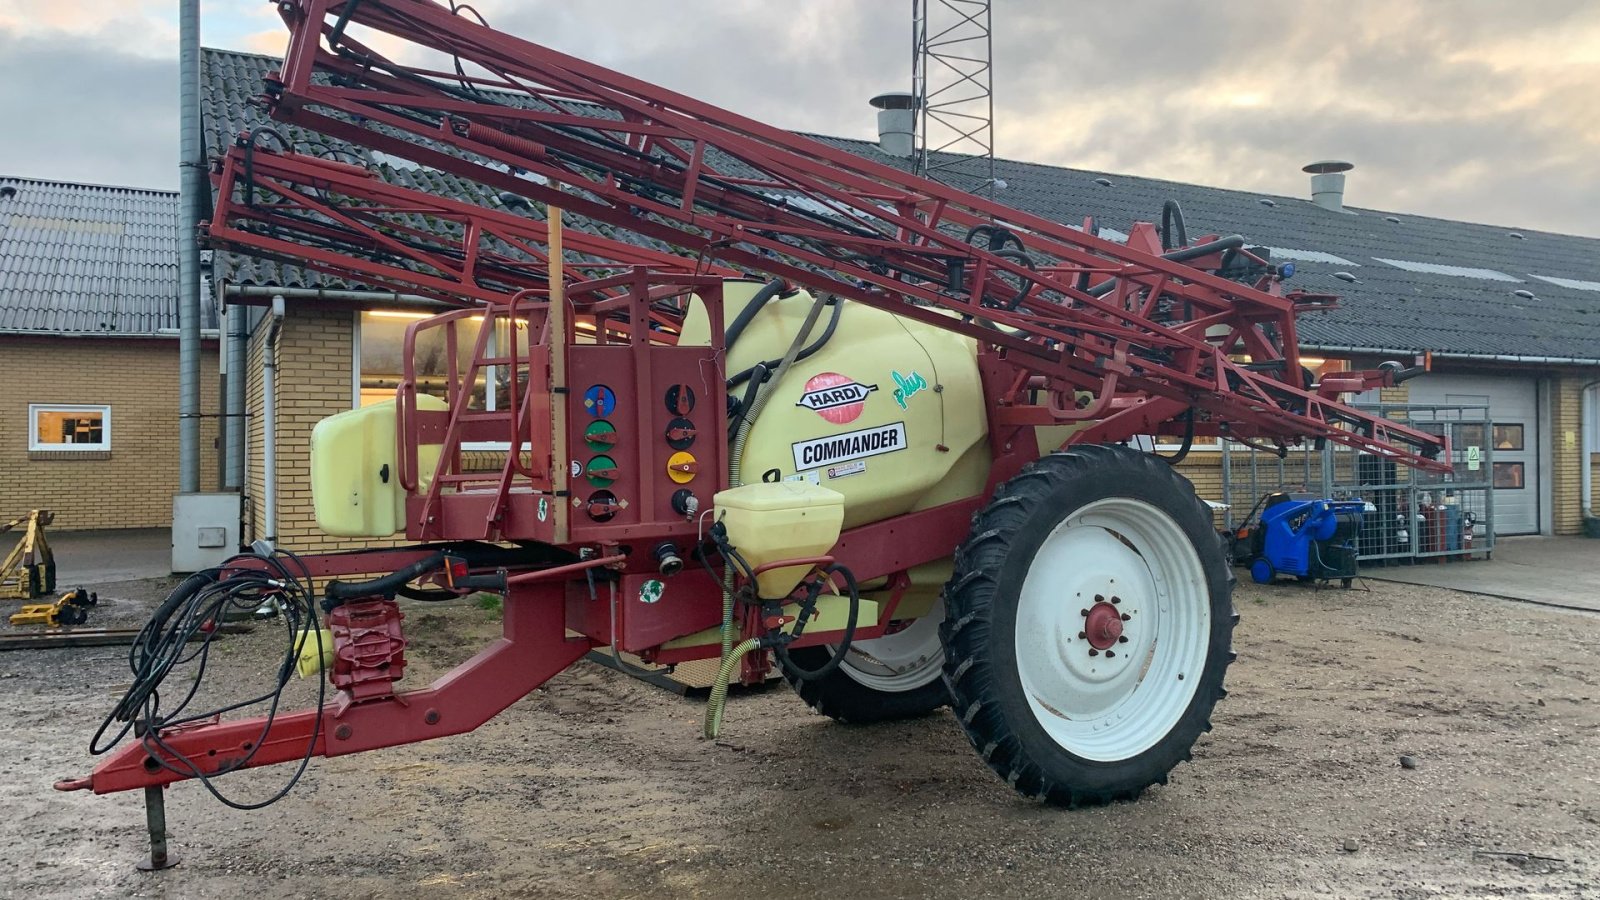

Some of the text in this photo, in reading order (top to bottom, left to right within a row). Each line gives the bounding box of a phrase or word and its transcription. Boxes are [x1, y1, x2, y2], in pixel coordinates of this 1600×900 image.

[808, 387, 862, 407] HARDI
[891, 370, 927, 410] plus
[803, 428, 898, 465] COMMANDER
